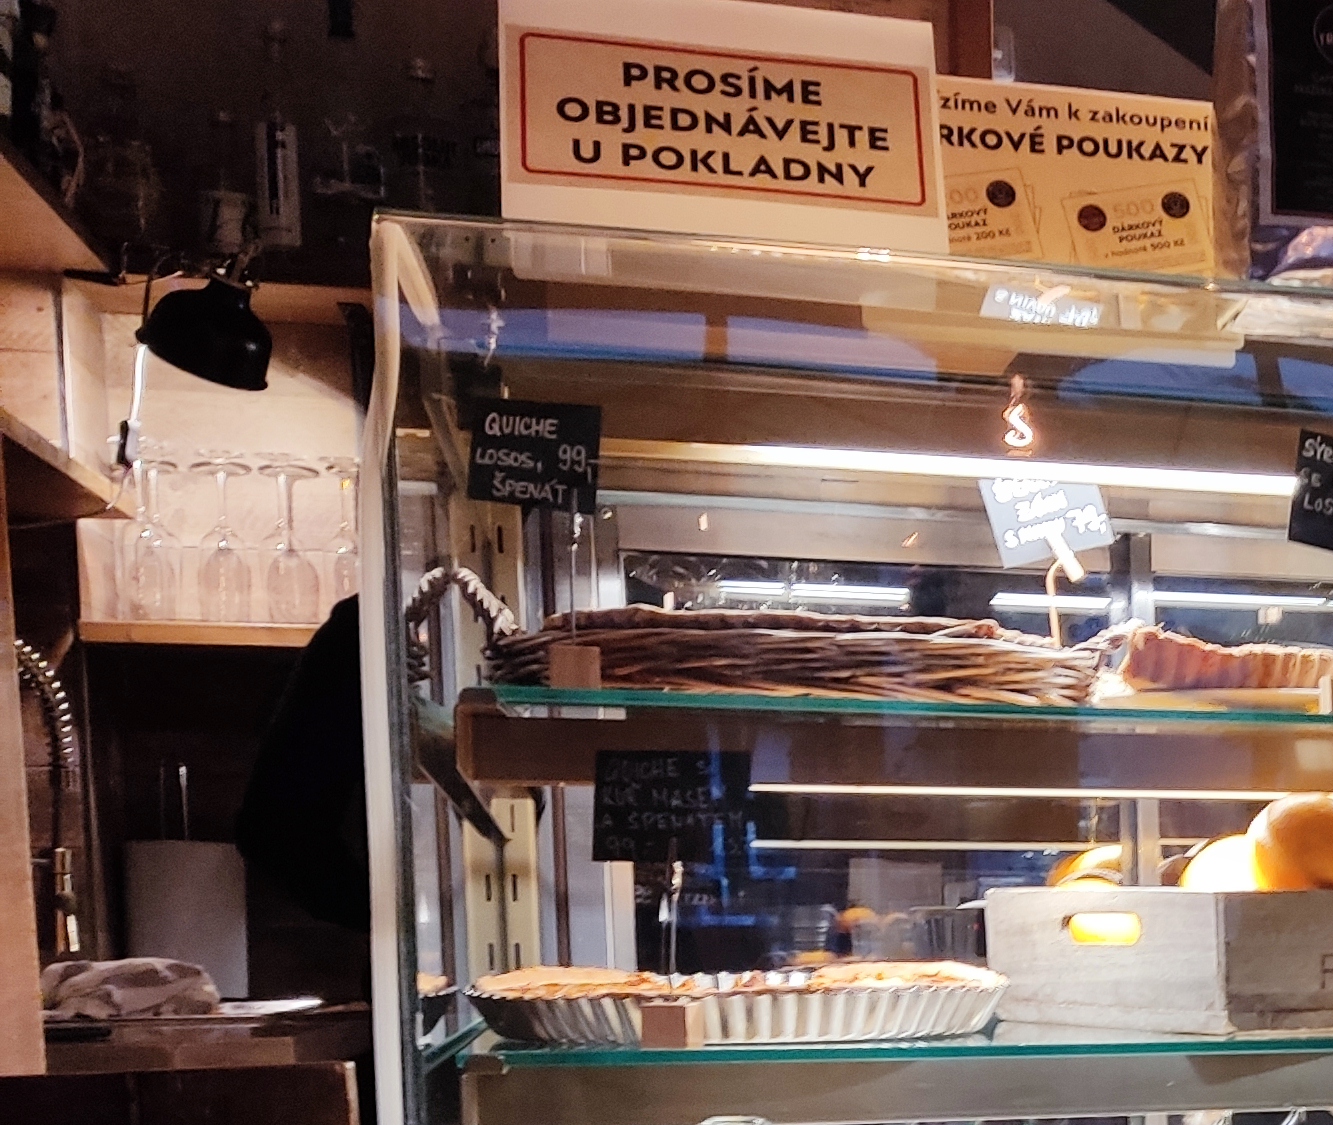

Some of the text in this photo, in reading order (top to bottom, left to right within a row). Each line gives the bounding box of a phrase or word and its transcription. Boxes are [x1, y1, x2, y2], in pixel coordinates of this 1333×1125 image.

[621, 61, 822, 106] PROSÍME
[556, 96, 890, 152] OBJEDNÁVEJTE
[939, 91, 1209, 133] zíme Vám k zakoupení
[571, 140, 875, 189] U POKLADNY
[939, 124, 1209, 165] RKOVÉ POUKAZY
[485, 412, 559, 439] QUICHE
[491, 470, 568, 505] ŠPENÁT
